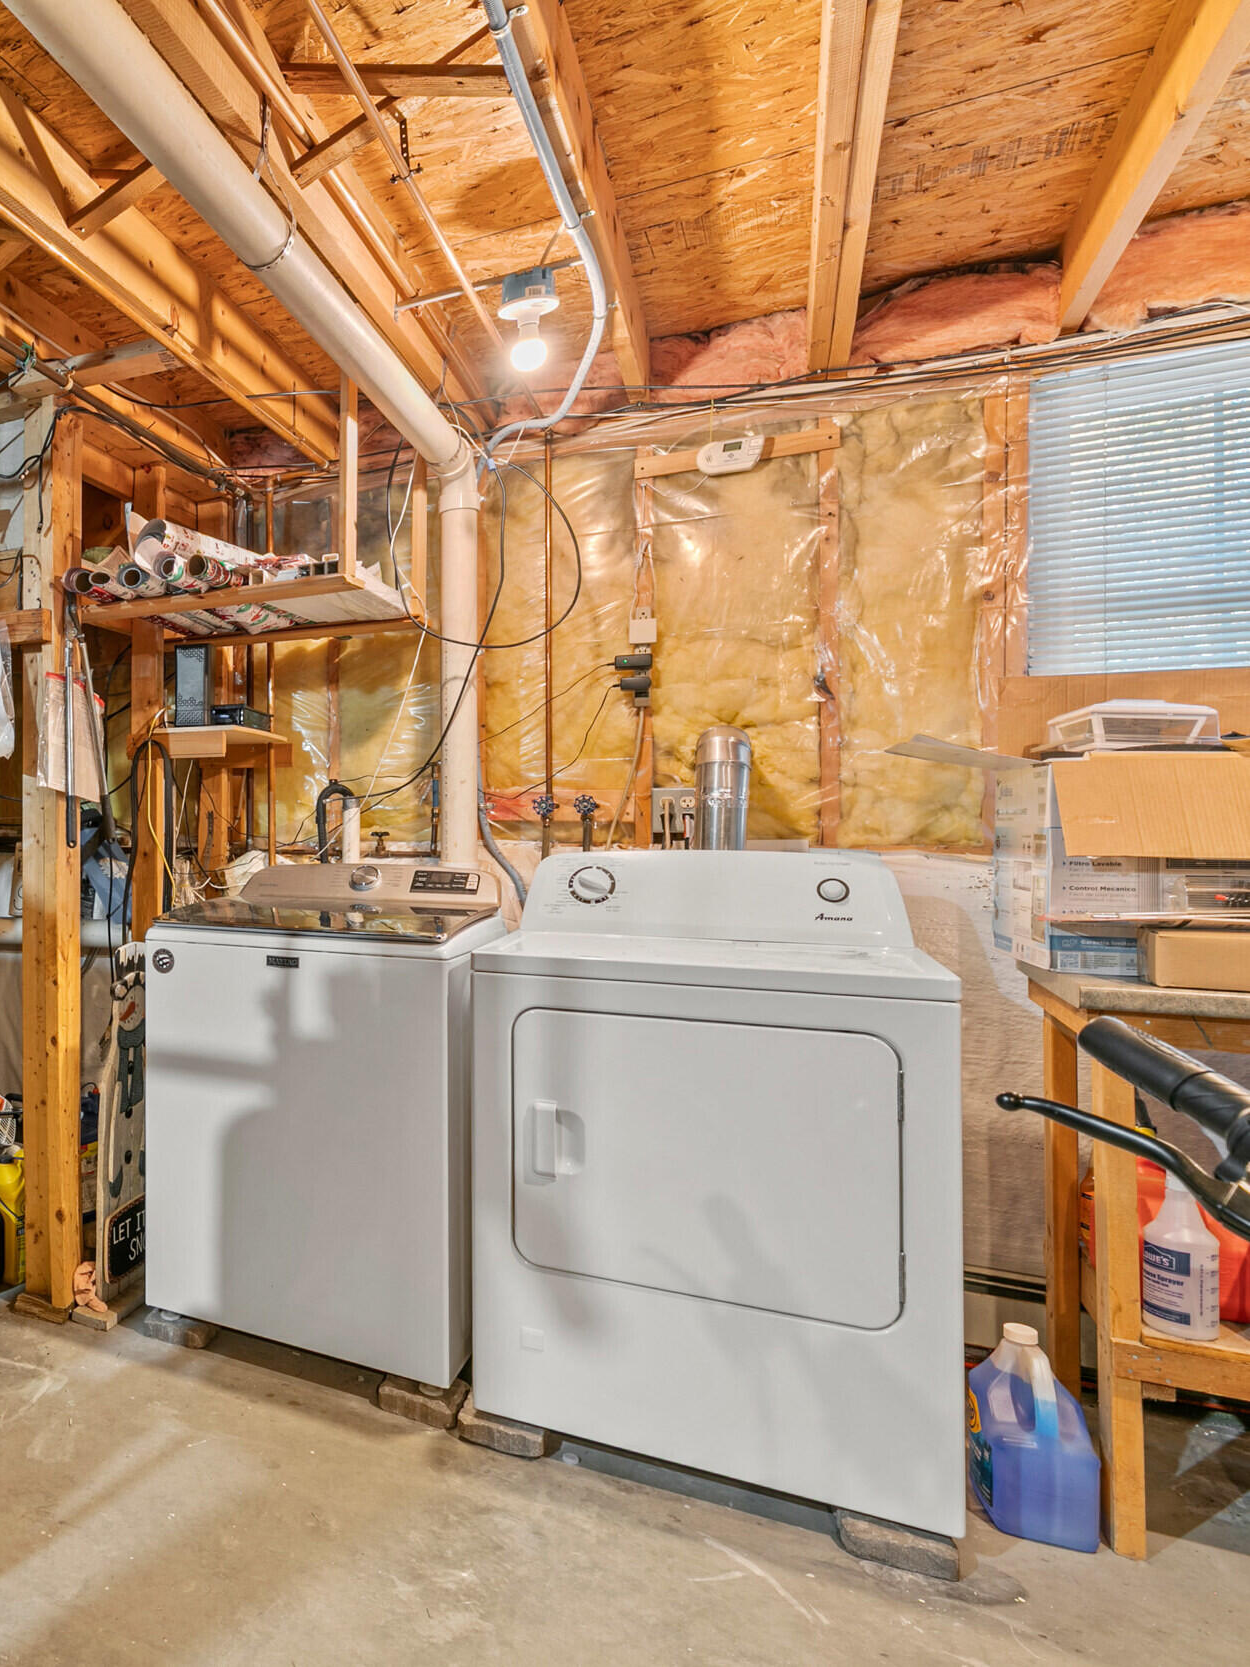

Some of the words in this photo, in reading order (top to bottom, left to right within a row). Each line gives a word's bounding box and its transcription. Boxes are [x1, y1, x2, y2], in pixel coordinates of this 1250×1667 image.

[814, 912, 853, 922] Amana
[112, 1217, 132, 1245] LET
[128, 1232, 146, 1261] SN
